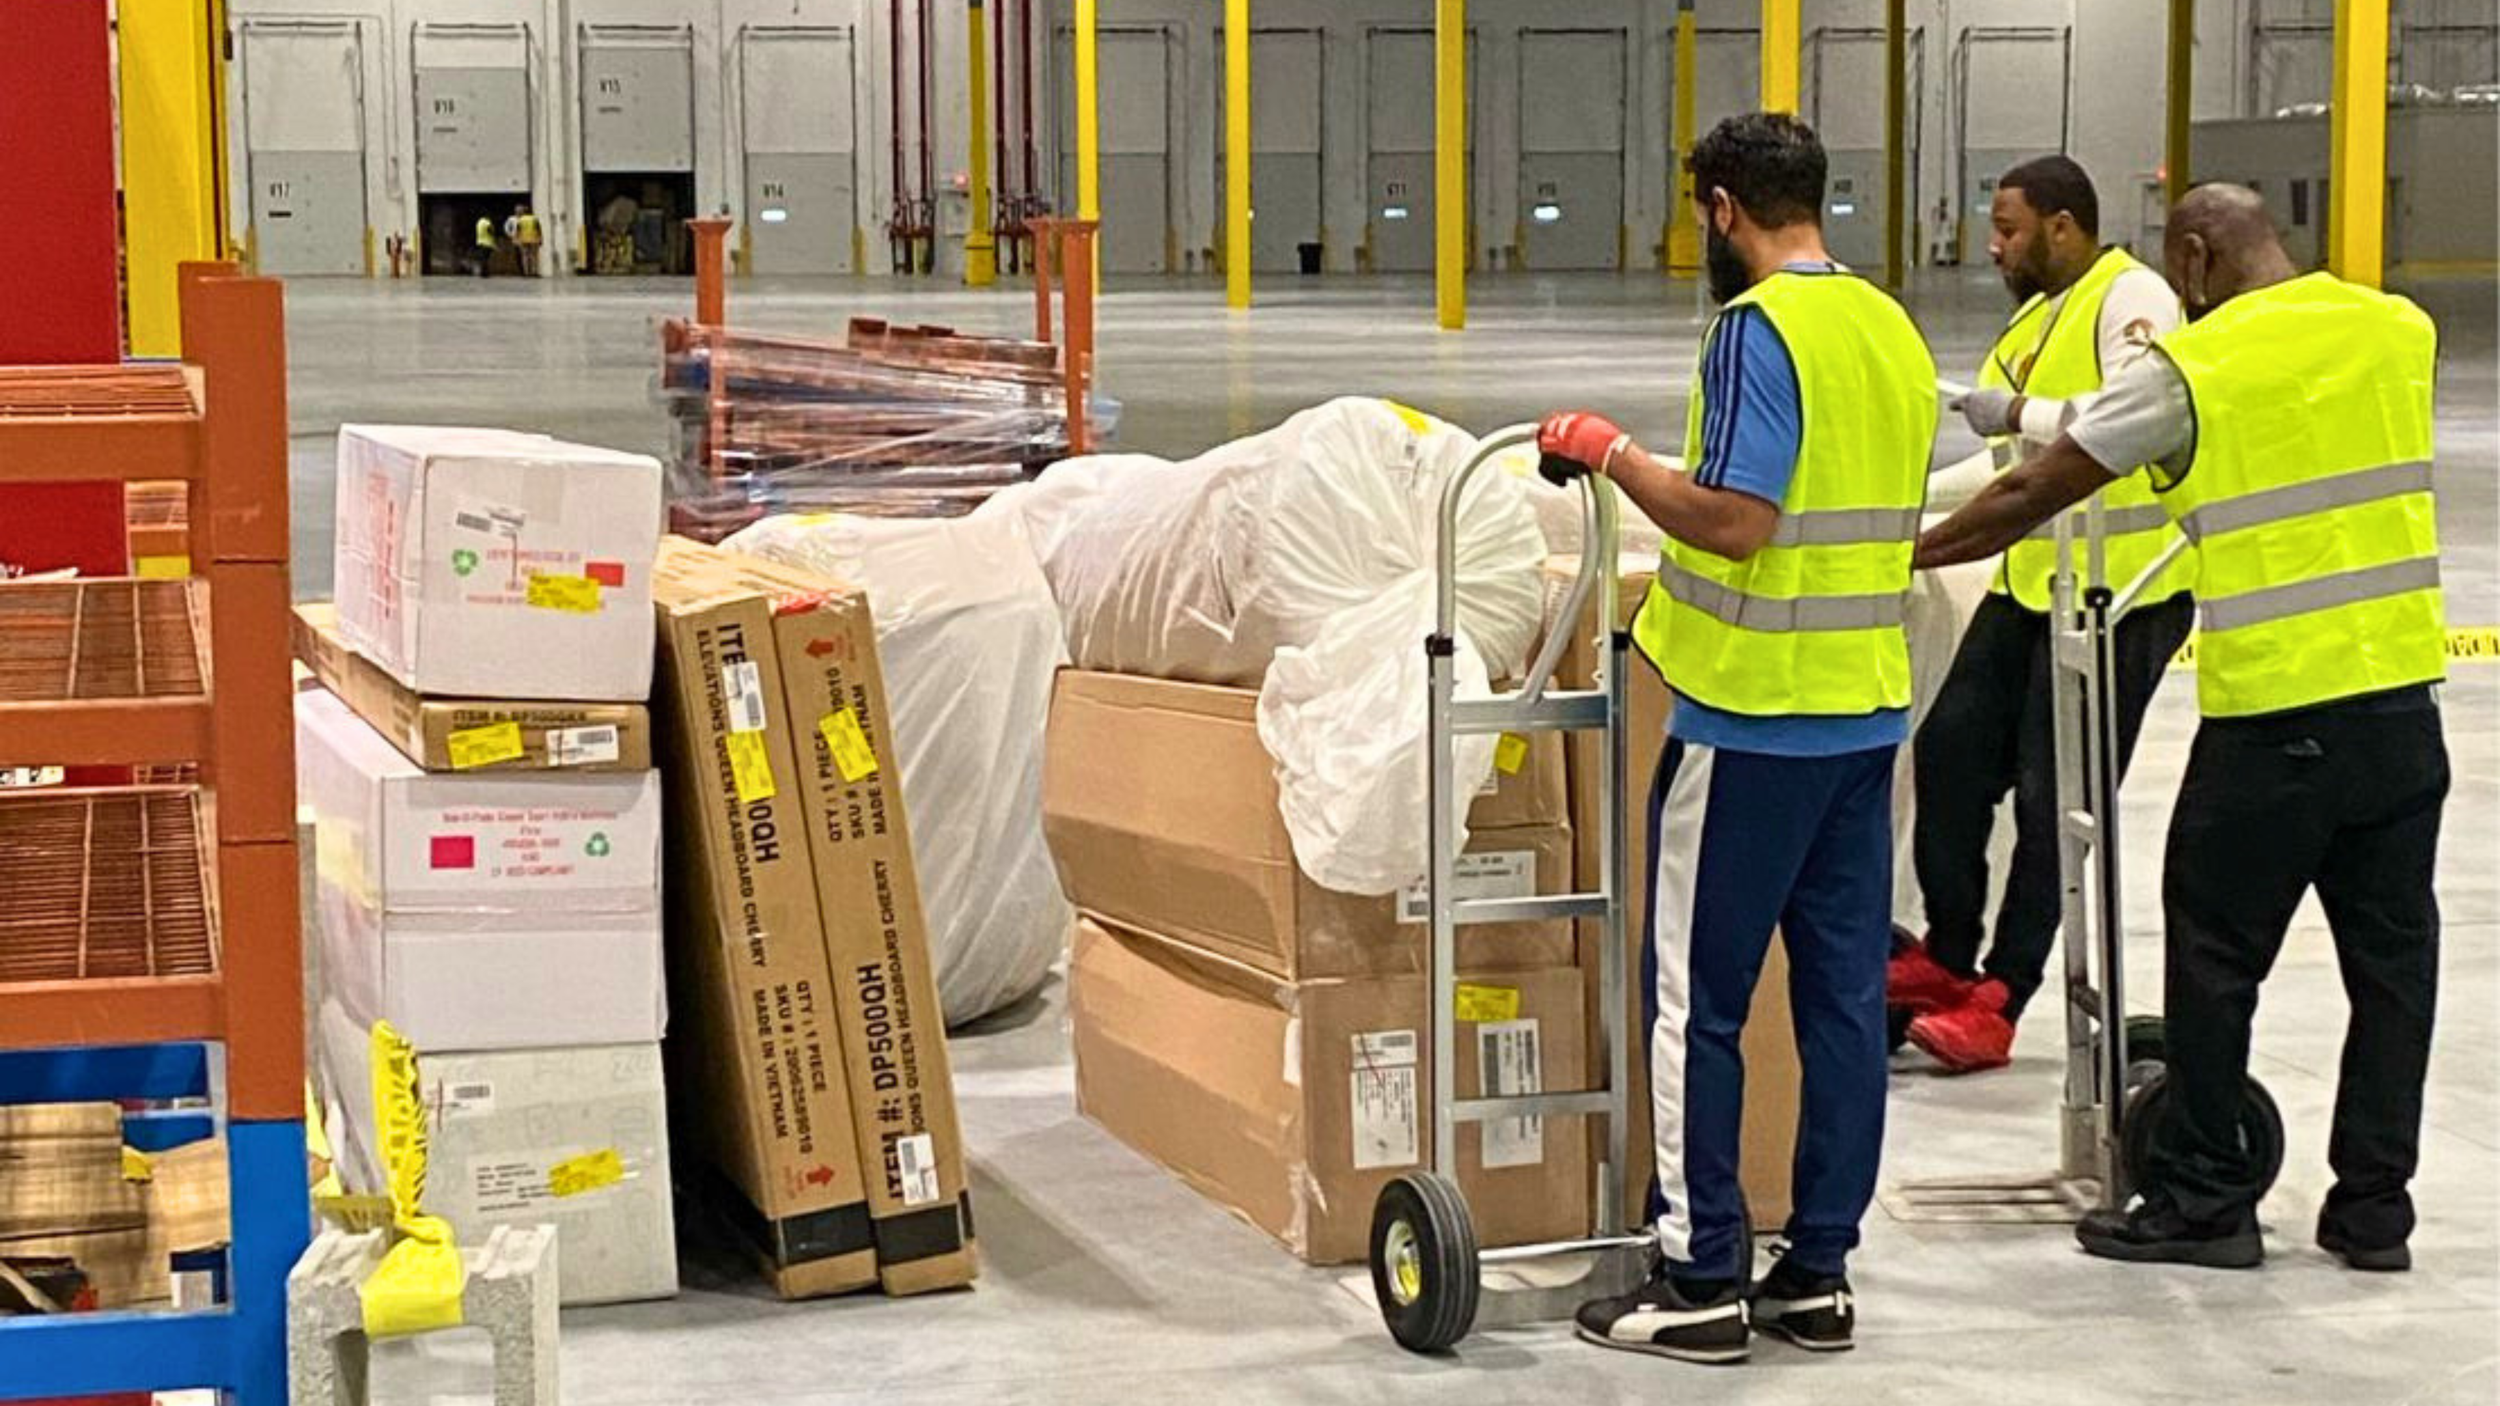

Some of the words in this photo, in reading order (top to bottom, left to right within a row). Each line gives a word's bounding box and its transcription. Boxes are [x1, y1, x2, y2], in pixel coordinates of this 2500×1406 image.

[696, 629, 726, 733] ELEVATIONS
[724, 796, 754, 898] HEADBOARD
[825, 809, 843, 842] QTY
[848, 804, 865, 839] SKU
[867, 787, 887, 835] MADE
[873, 860, 895, 925] CHERRY
[774, 984, 792, 1020] SKU
[883, 928, 911, 1029] HEADBOARD
[753, 989, 772, 1037] MADE
[796, 980, 814, 1014] QTY
[807, 1043, 827, 1092] PIECE
[856, 963, 899, 1092] DP500QH
[761, 1040, 775, 1060] IN
[900, 1032, 919, 1089] QUEEN
[765, 1063, 789, 1139] VIETNAM
